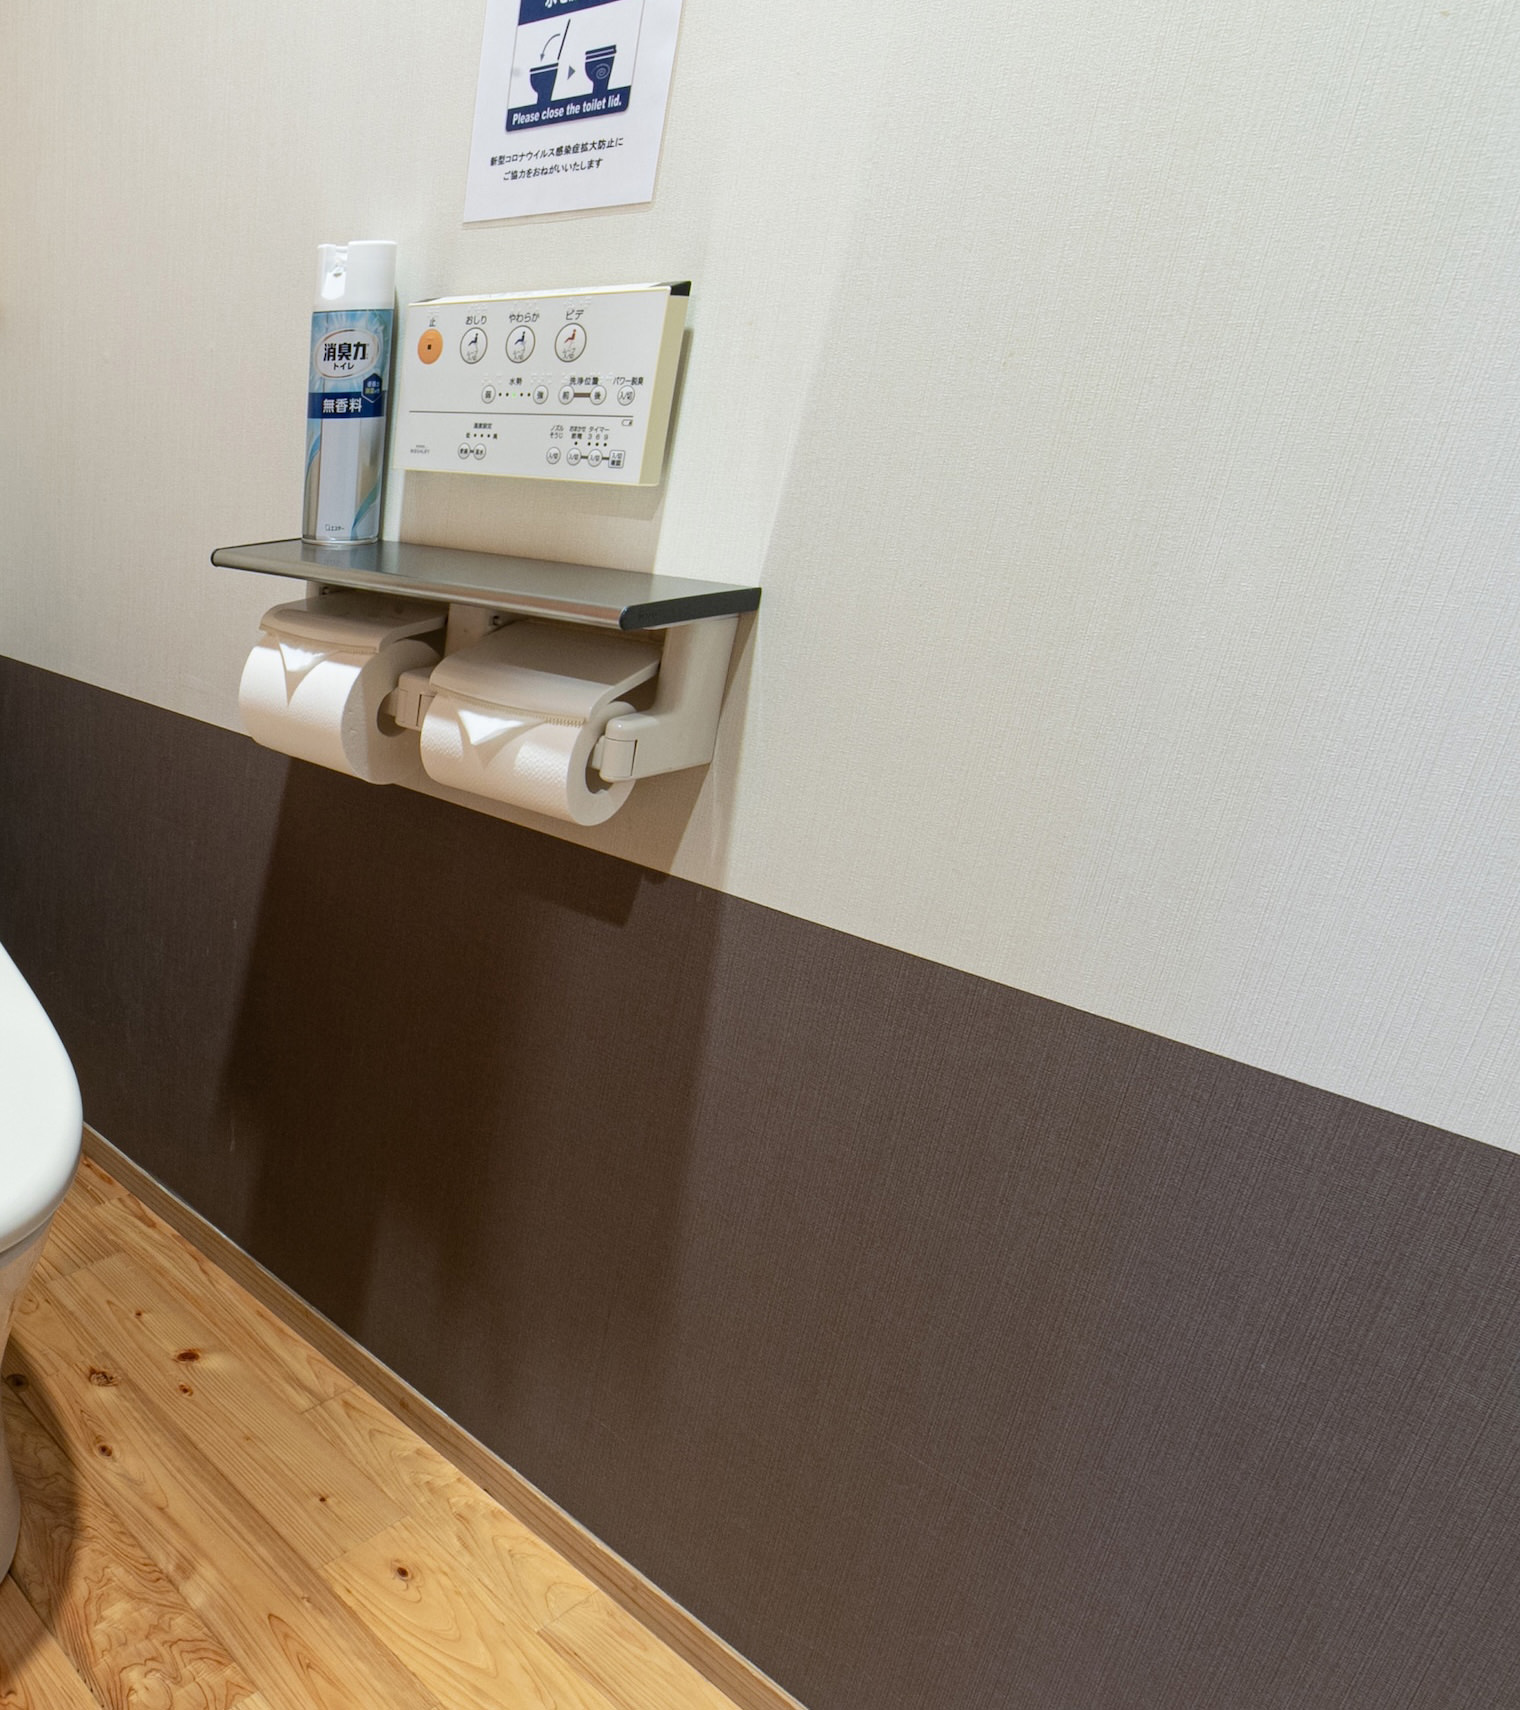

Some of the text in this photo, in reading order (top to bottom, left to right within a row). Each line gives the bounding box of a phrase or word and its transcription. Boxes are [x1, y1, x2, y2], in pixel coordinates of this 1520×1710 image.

[511, 93, 622, 126] Please close the toilet lid.
[490, 137, 624, 167] 新型コロナウイルス感染症拡大防止に
[503, 157, 604, 181] ご協力をおねがいいたします
[465, 315, 488, 325] おしり
[508, 312, 540, 323] やわらか
[565, 309, 585, 321] ビデ
[323, 341, 367, 361] 消臭力
[333, 362, 355, 371] トイレ
[322, 397, 362, 414] 無香料
